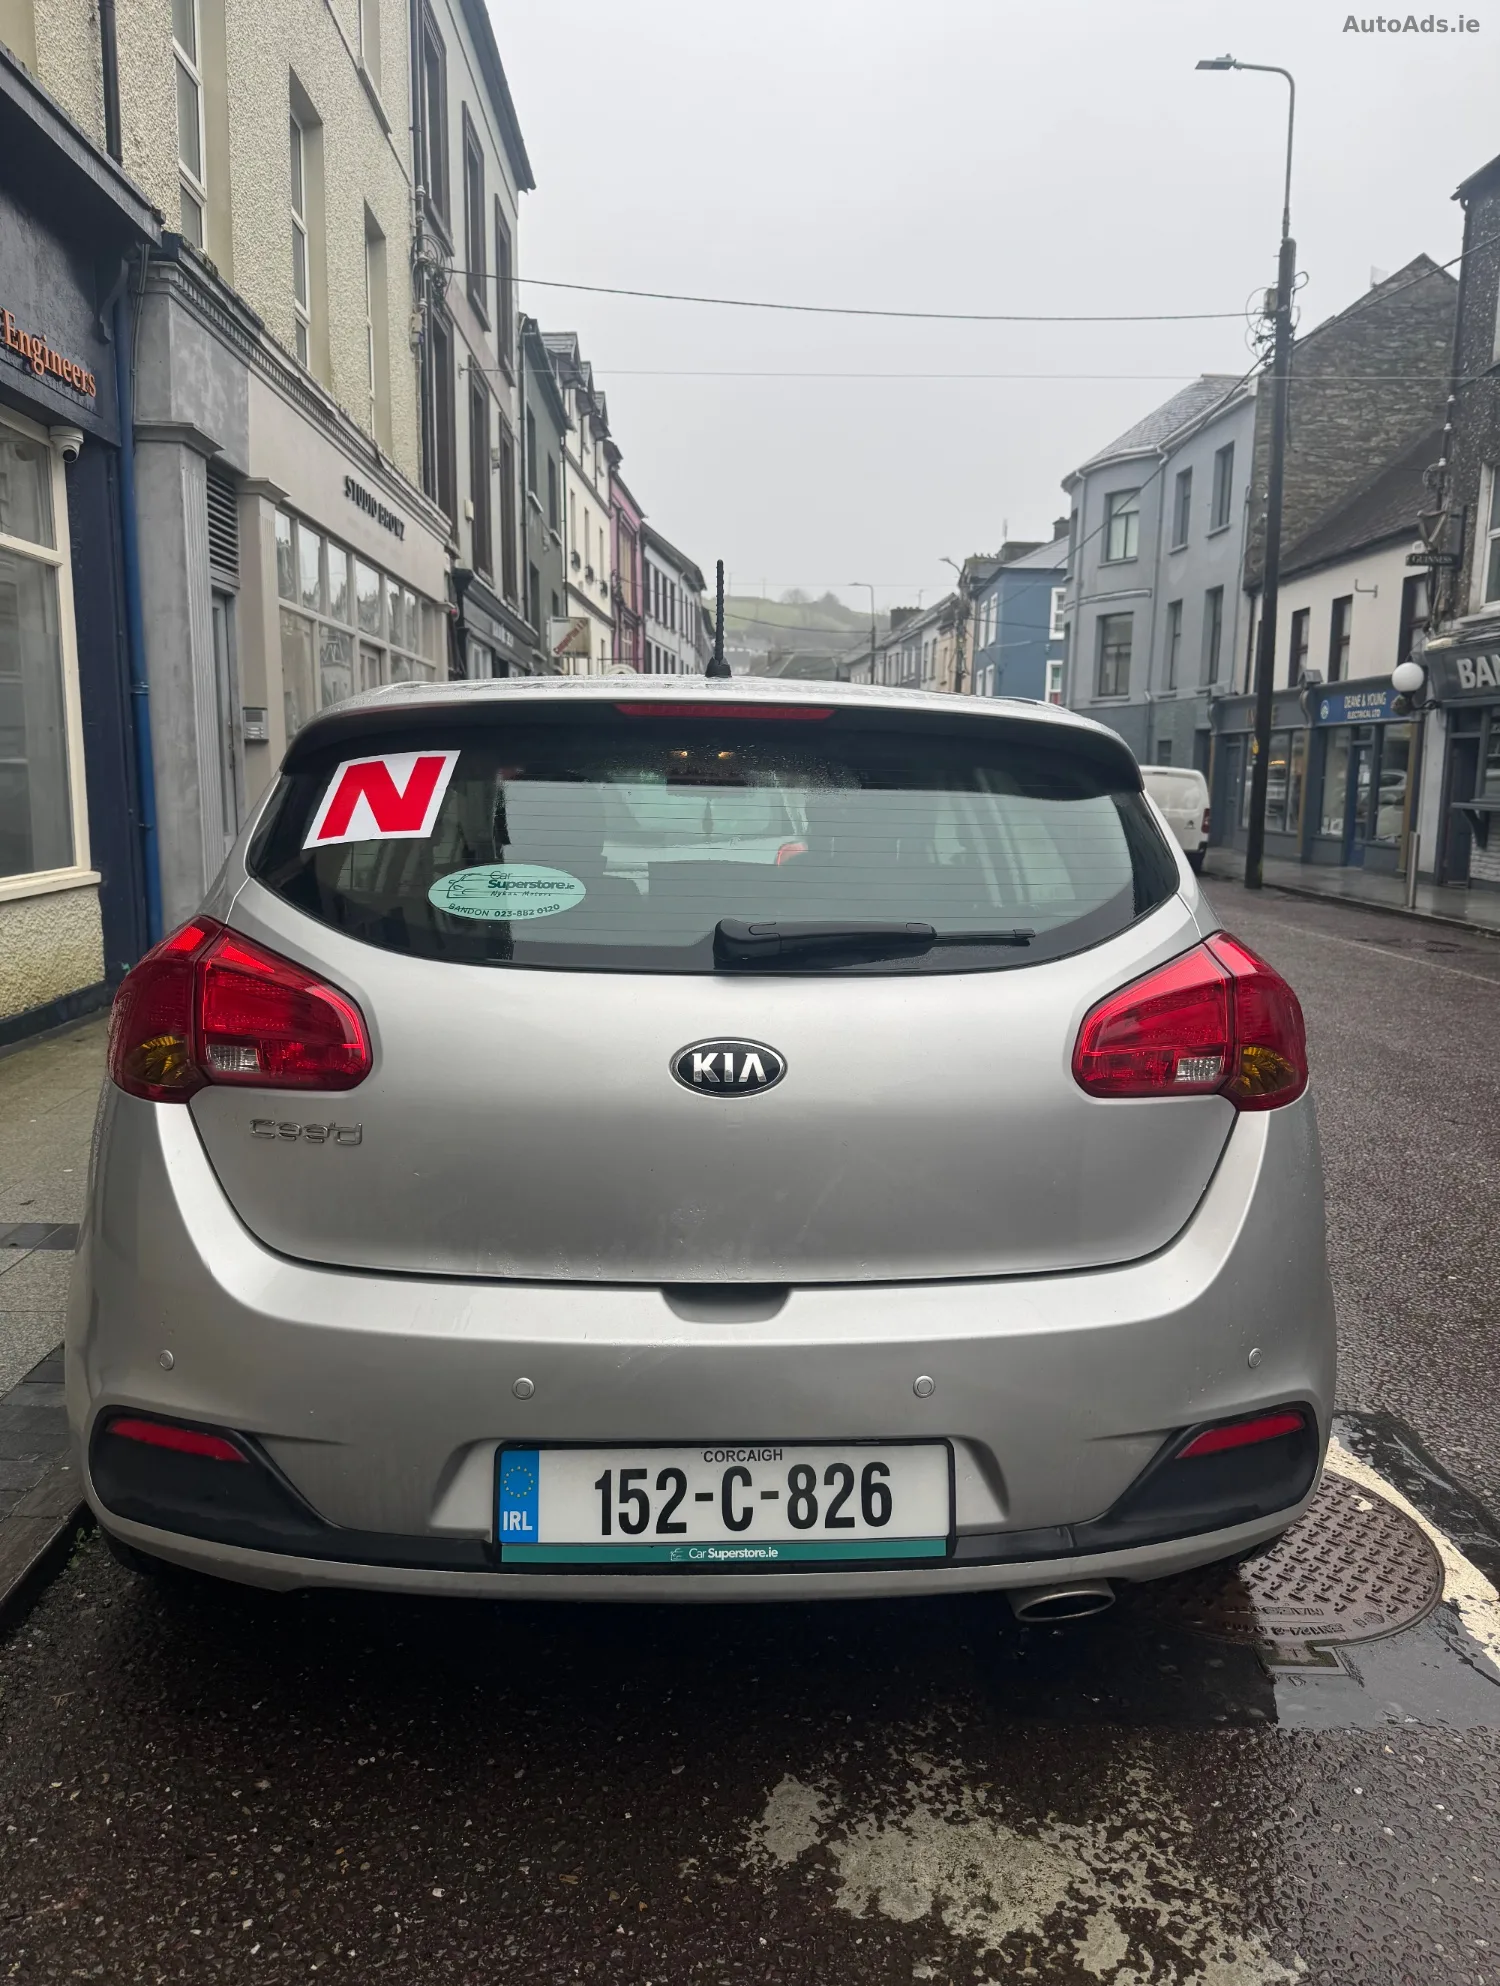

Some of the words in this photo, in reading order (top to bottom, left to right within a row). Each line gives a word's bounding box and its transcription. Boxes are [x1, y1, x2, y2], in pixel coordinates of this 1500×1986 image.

[1, 306, 96, 397] Engineers
[344, 475, 377, 518] STUDIO
[1411, 554, 1453, 564] GUINNESS
[1344, 694, 1361, 708] DEANE
[1361, 693, 1367, 707] &
[1367, 692, 1387, 706] YOUNG
[1346, 709, 1372, 719] ELECTRICAL
[1371, 708, 1381, 718] LTD
[317, 755, 447, 841] N
[489, 870, 513, 880] Car
[487, 879, 576, 891] Superstore.ie
[448, 903, 490, 917] BANDON
[494, 909, 535, 917] 023-882
[537, 903, 560, 914] 0120
[692, 1052, 767, 1083] KIA
[703, 1448, 783, 1463] CORCAIGH
[594, 1461, 893, 1536] 152-C-826
[502, 1510, 533, 1531] IRL
[688, 1547, 706, 1559] Car
[707, 1547, 779, 1560] Superstore.ie
